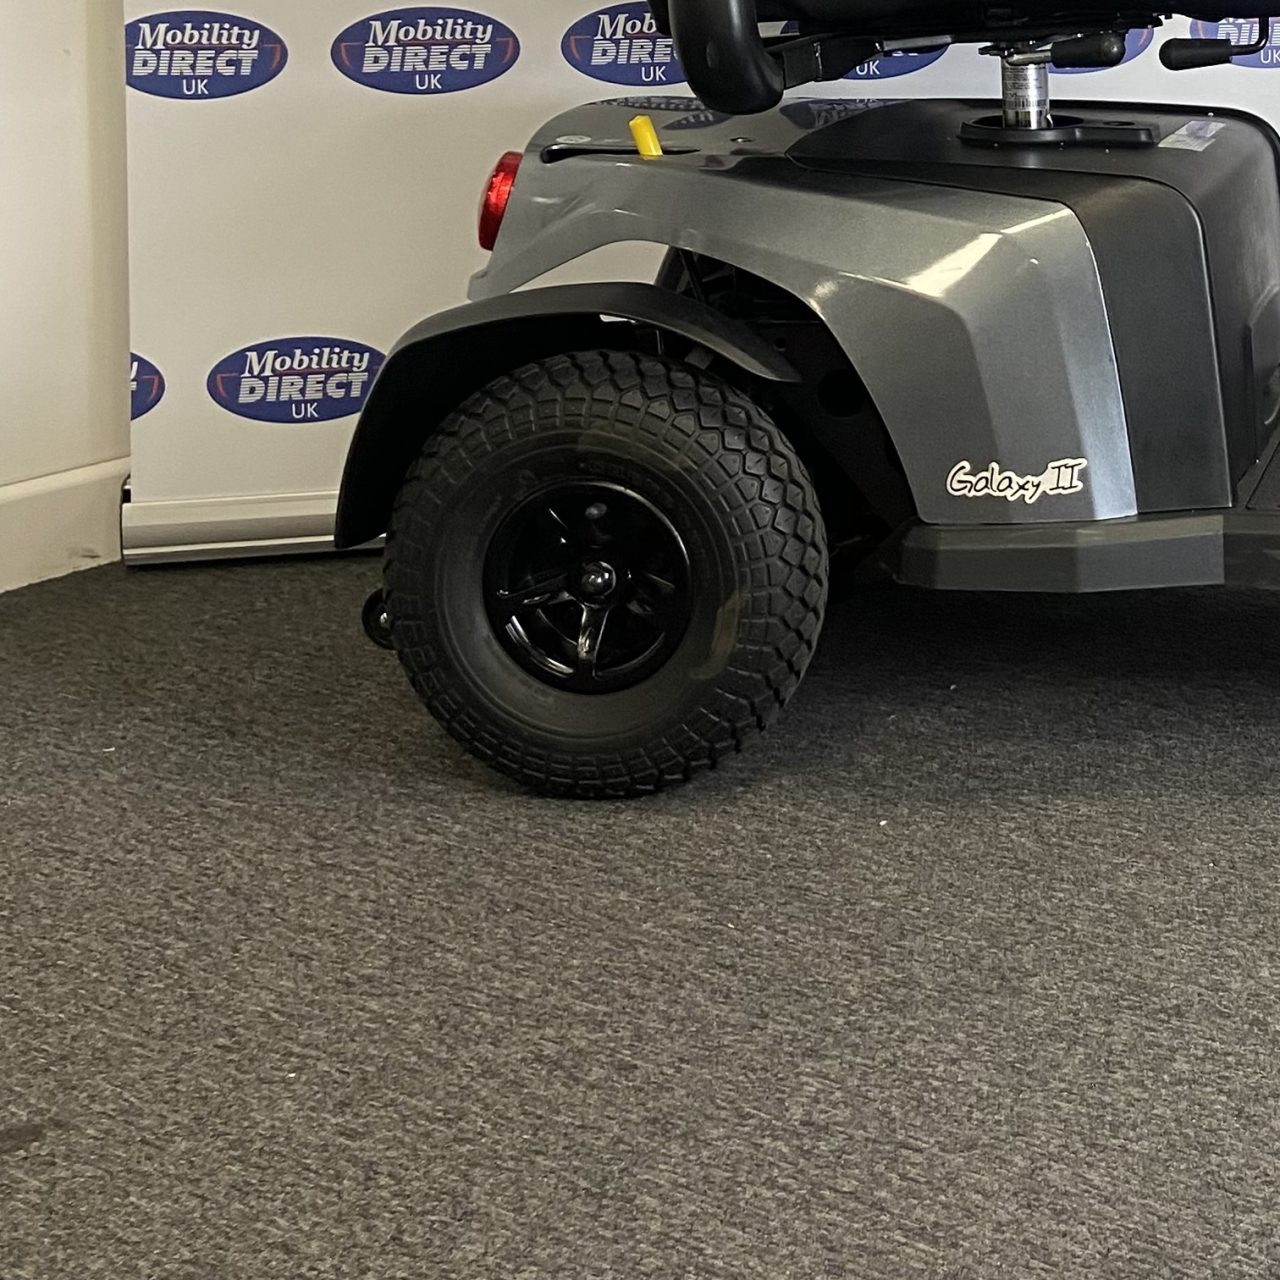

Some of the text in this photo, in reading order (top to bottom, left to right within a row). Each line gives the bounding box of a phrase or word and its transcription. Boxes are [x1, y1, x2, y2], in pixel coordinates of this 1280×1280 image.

[132, 22, 259, 49] Mobility
[364, 18, 493, 47] Mobility
[130, 49, 258, 76] DIRECT
[362, 43, 492, 73] DIRECT
[183, 78, 209, 94] UK
[415, 73, 441, 90] UK
[641, 66, 666, 81] UK
[240, 347, 370, 377] Mobility
[237, 371, 368, 403] DIRECT
[291, 402, 317, 418] UK
[947, 460, 1085, 501] Galaxy II
